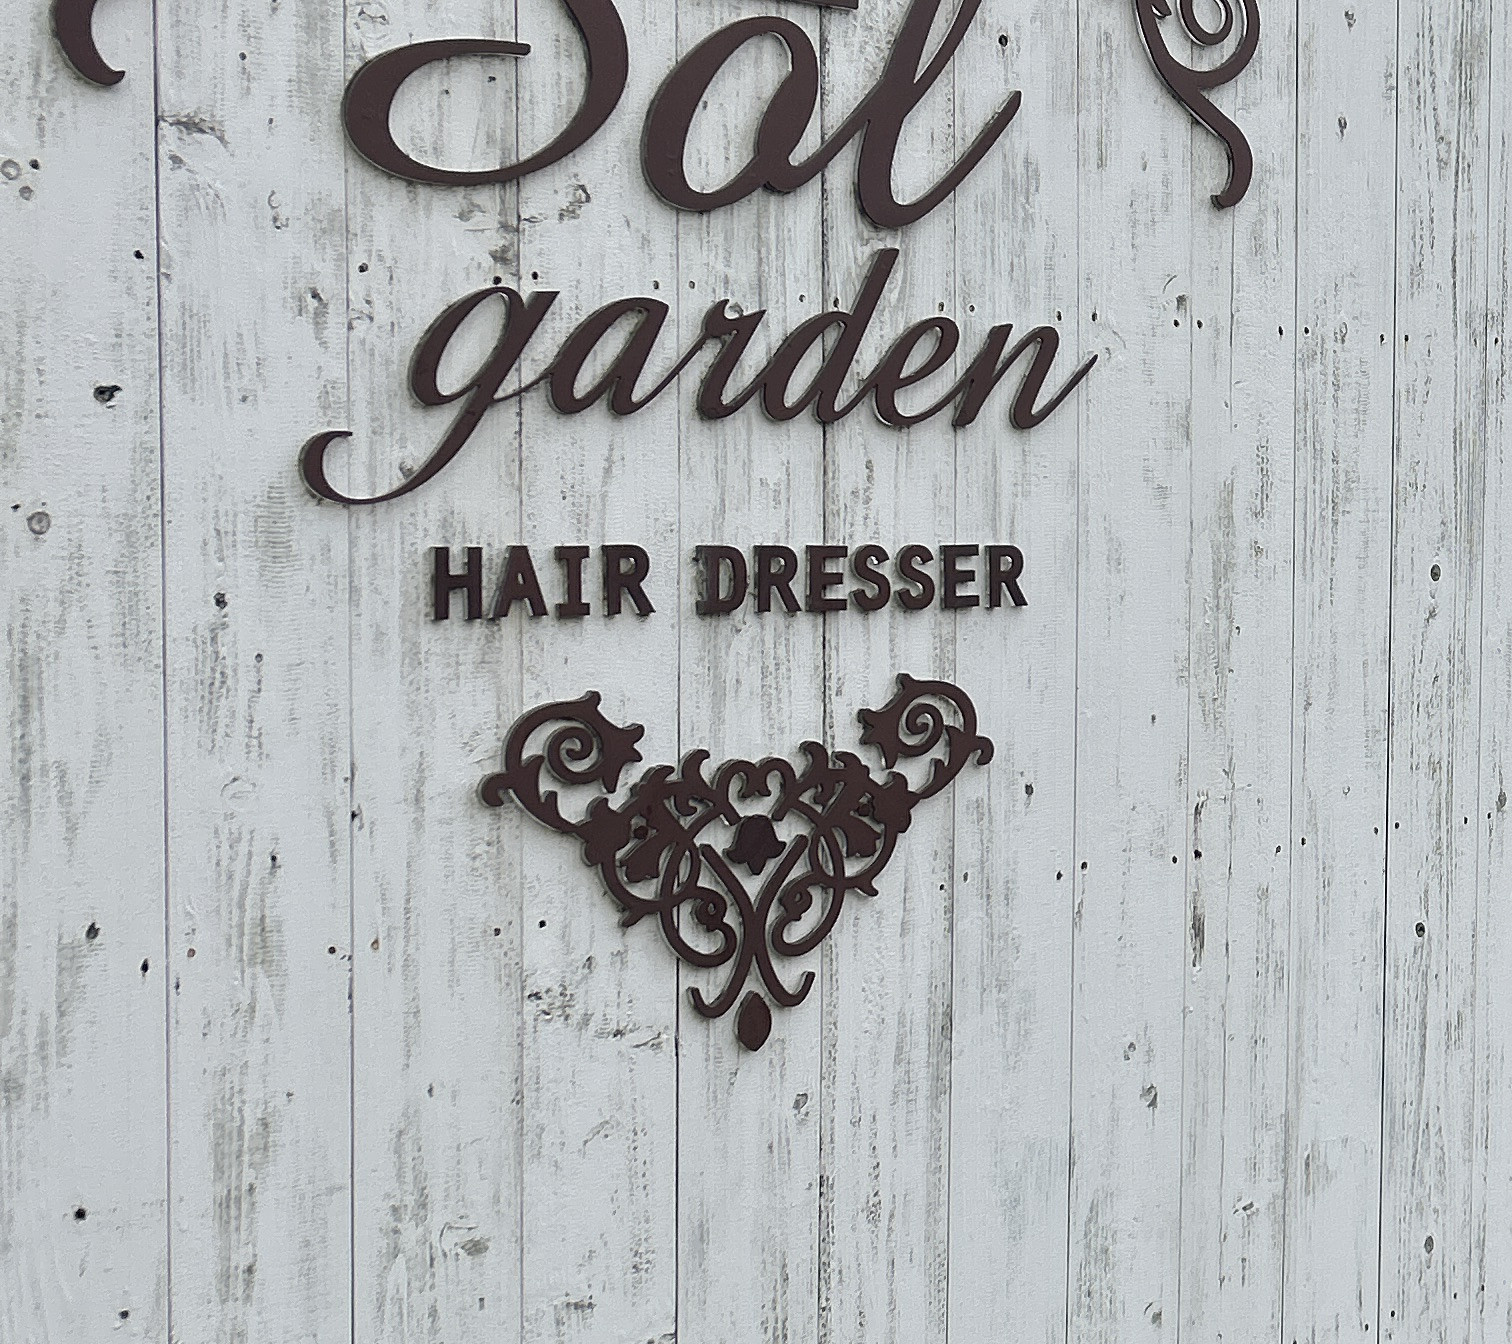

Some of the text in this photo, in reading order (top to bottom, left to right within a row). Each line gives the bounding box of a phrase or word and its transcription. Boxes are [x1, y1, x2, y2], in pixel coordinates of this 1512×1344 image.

[298, 247, 1099, 506] garden
[431, 544, 1029, 621] HAIR DRESSER
